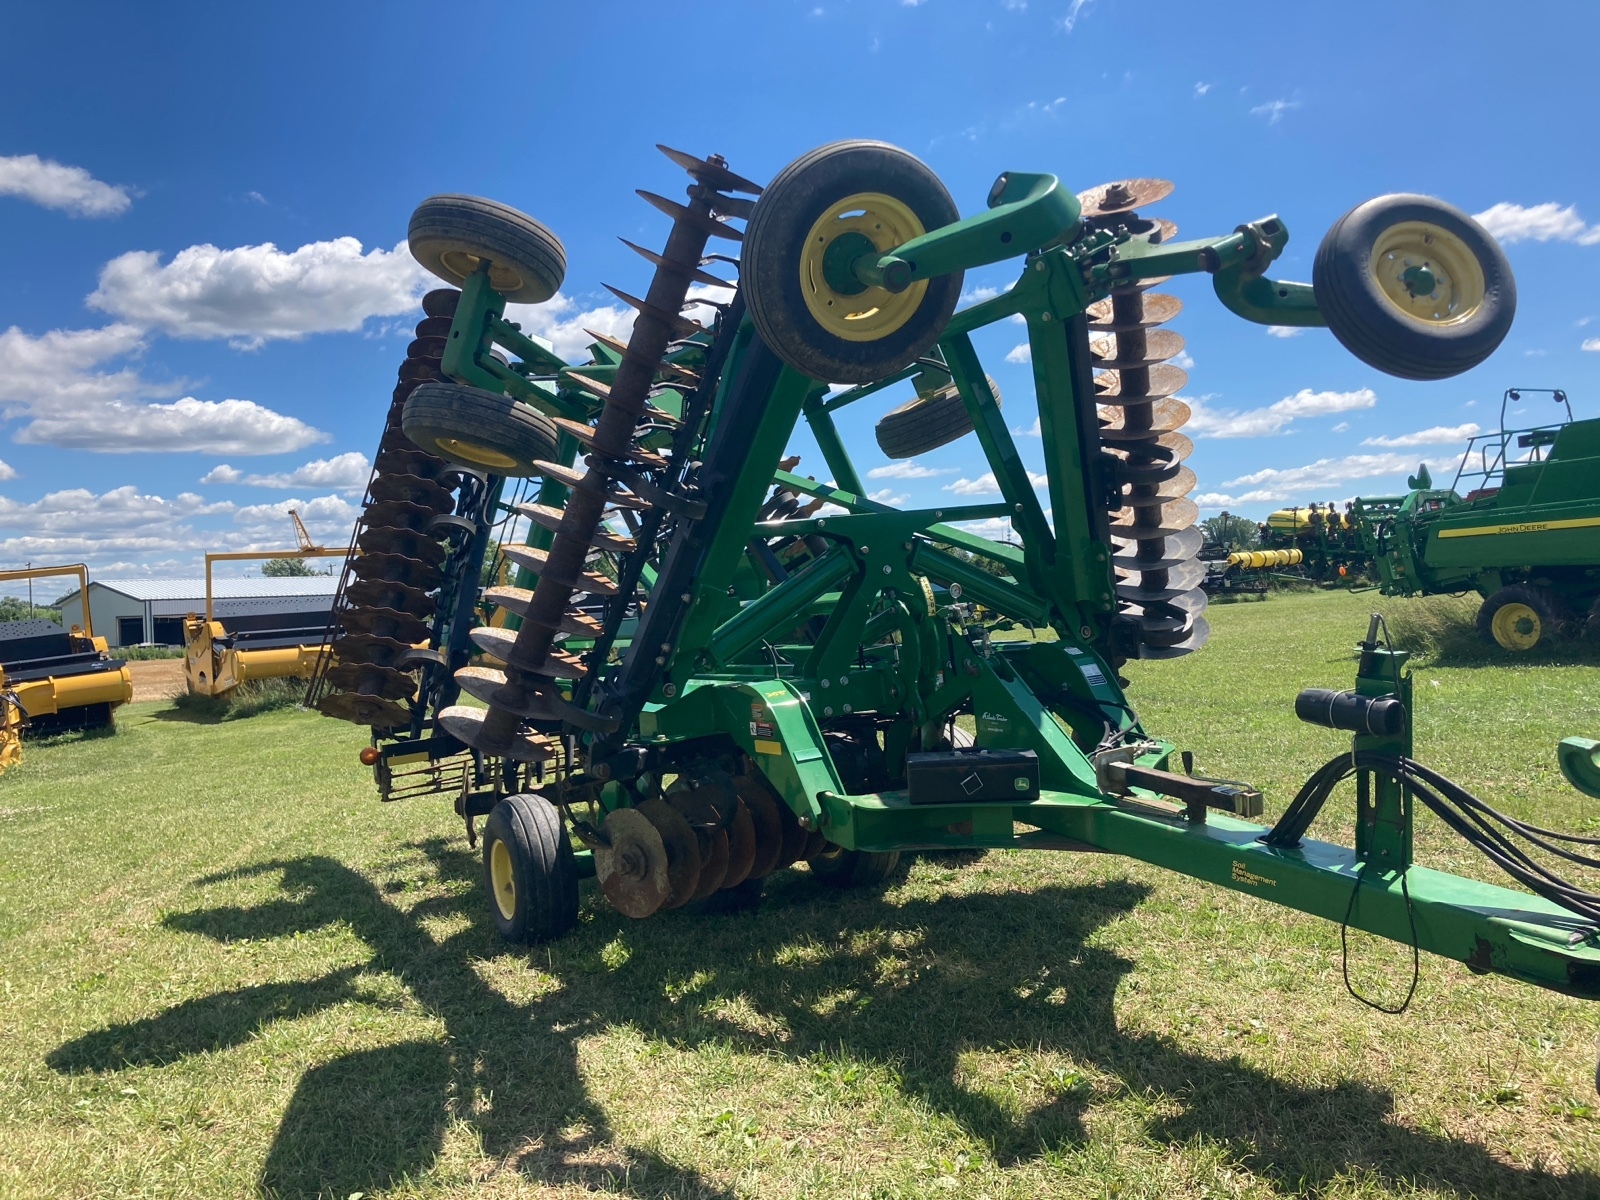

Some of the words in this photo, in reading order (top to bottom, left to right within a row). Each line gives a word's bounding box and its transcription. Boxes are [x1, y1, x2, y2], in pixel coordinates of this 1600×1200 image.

[1519, 524, 1548, 532] DEERE
[1232, 860, 1246, 870] Soil
[1231, 872, 1258, 886] System
[1232, 866, 1277, 887] Management
